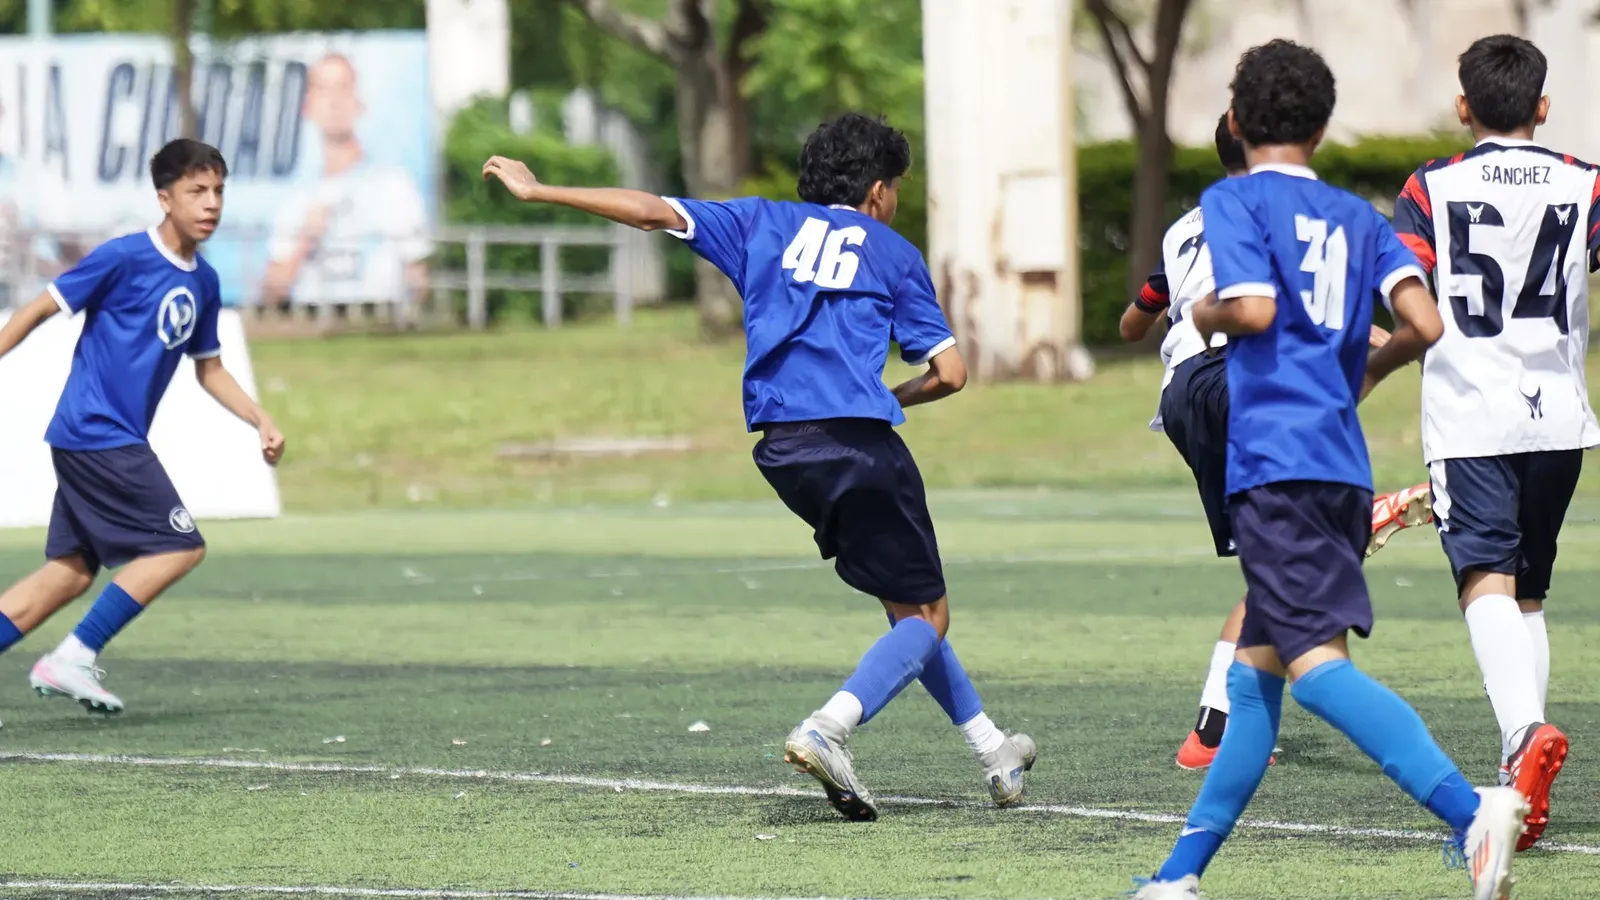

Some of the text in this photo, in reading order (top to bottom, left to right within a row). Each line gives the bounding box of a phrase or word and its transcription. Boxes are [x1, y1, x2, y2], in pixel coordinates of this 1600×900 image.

[1481, 164, 1551, 186] SANCHEZ
[781, 216, 867, 289] 46
[1294, 213, 1348, 330] 31
[1446, 200, 1579, 338] 54
